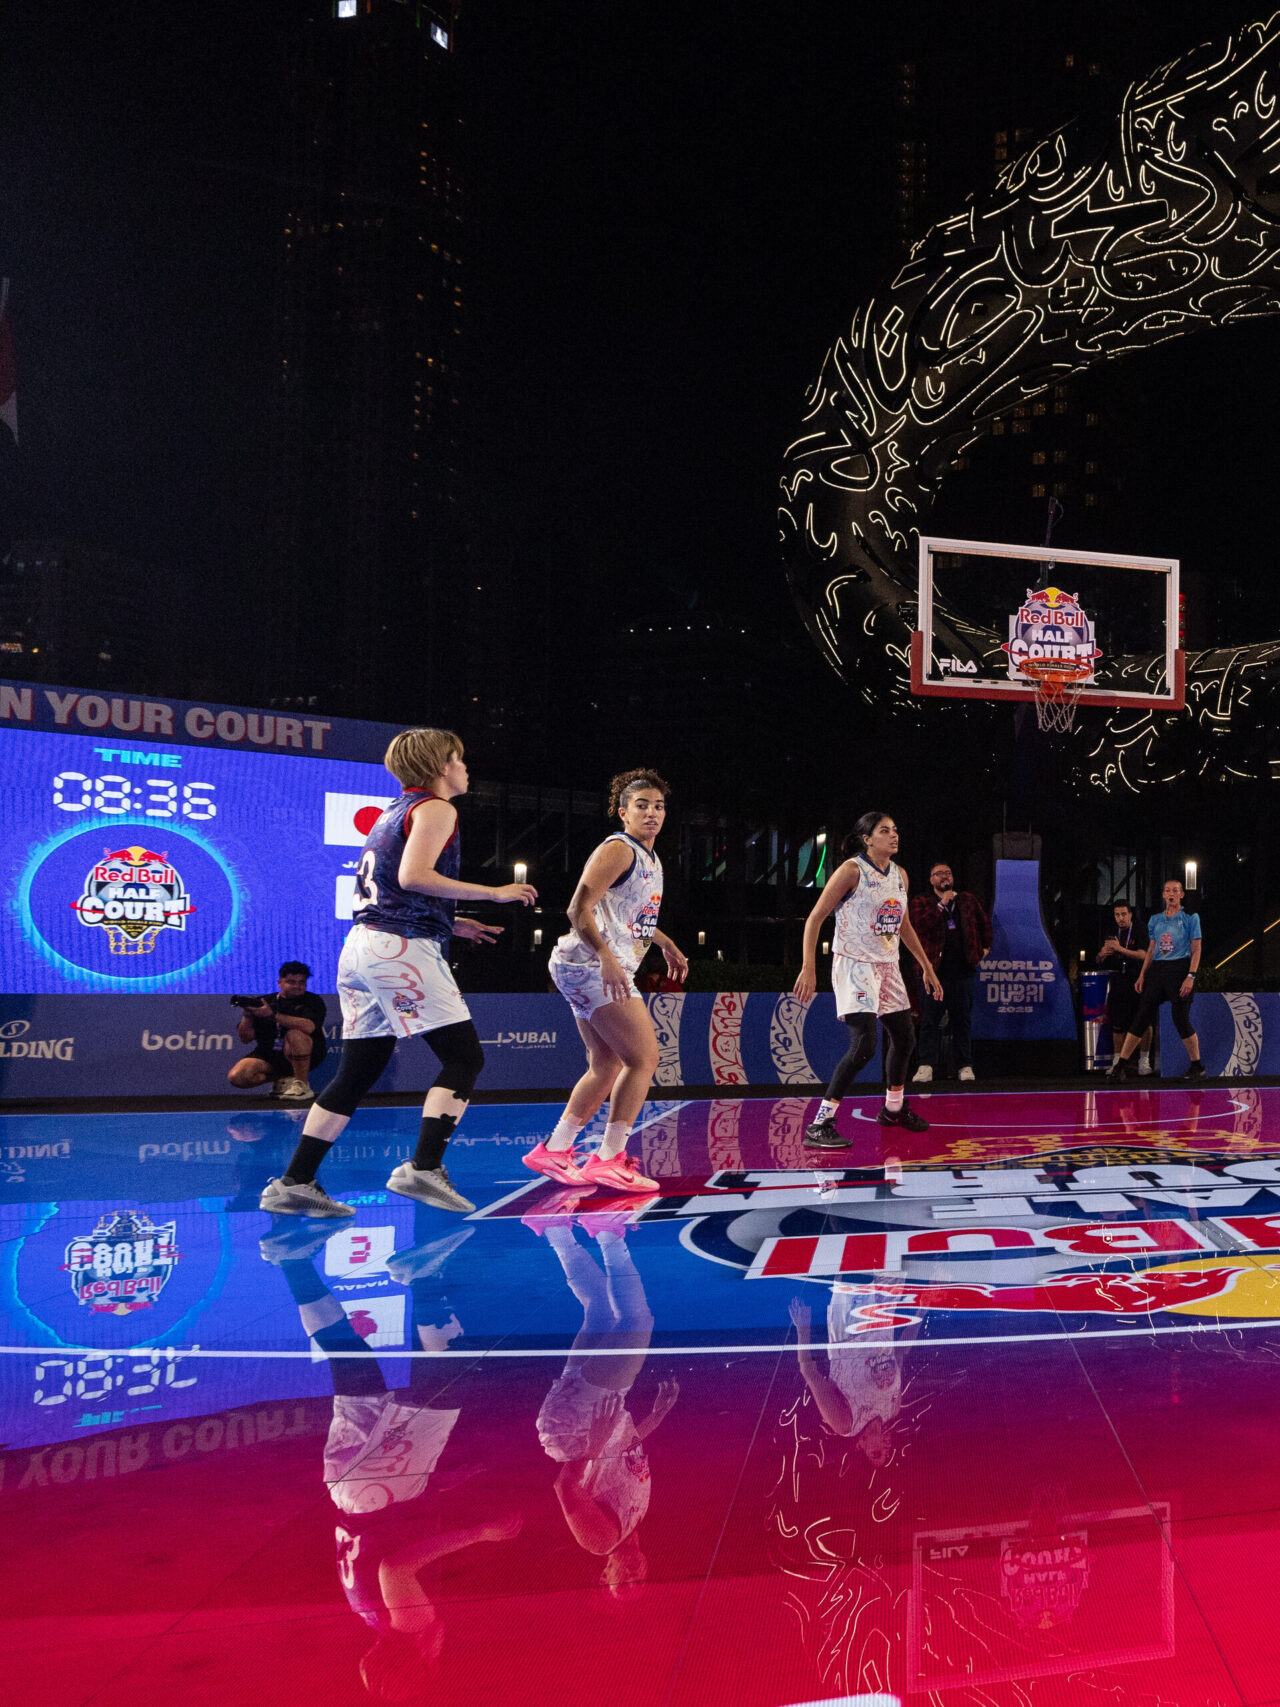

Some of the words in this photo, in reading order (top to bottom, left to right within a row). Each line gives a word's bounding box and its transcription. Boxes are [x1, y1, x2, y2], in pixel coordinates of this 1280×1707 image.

[1020, 608, 1051, 624] Red
[1054, 611, 1084, 627] Bull
[1031, 629, 1073, 643] HALF
[1011, 639, 1094, 667] COURT
[939, 658, 978, 673] FILA
[44, 690, 175, 736] YOUR
[185, 707, 333, 751] COURT
[93, 747, 183, 769] TIME
[53, 772, 217, 821] 08:36
[94, 866, 134, 882] Red
[138, 868, 175, 884] Bull
[107, 887, 161, 900] HALF
[81, 896, 186, 927] COURT
[979, 960, 1054, 971] WORLD
[979, 971, 1056, 983] FINALS
[141, 1029, 233, 1051] botim
